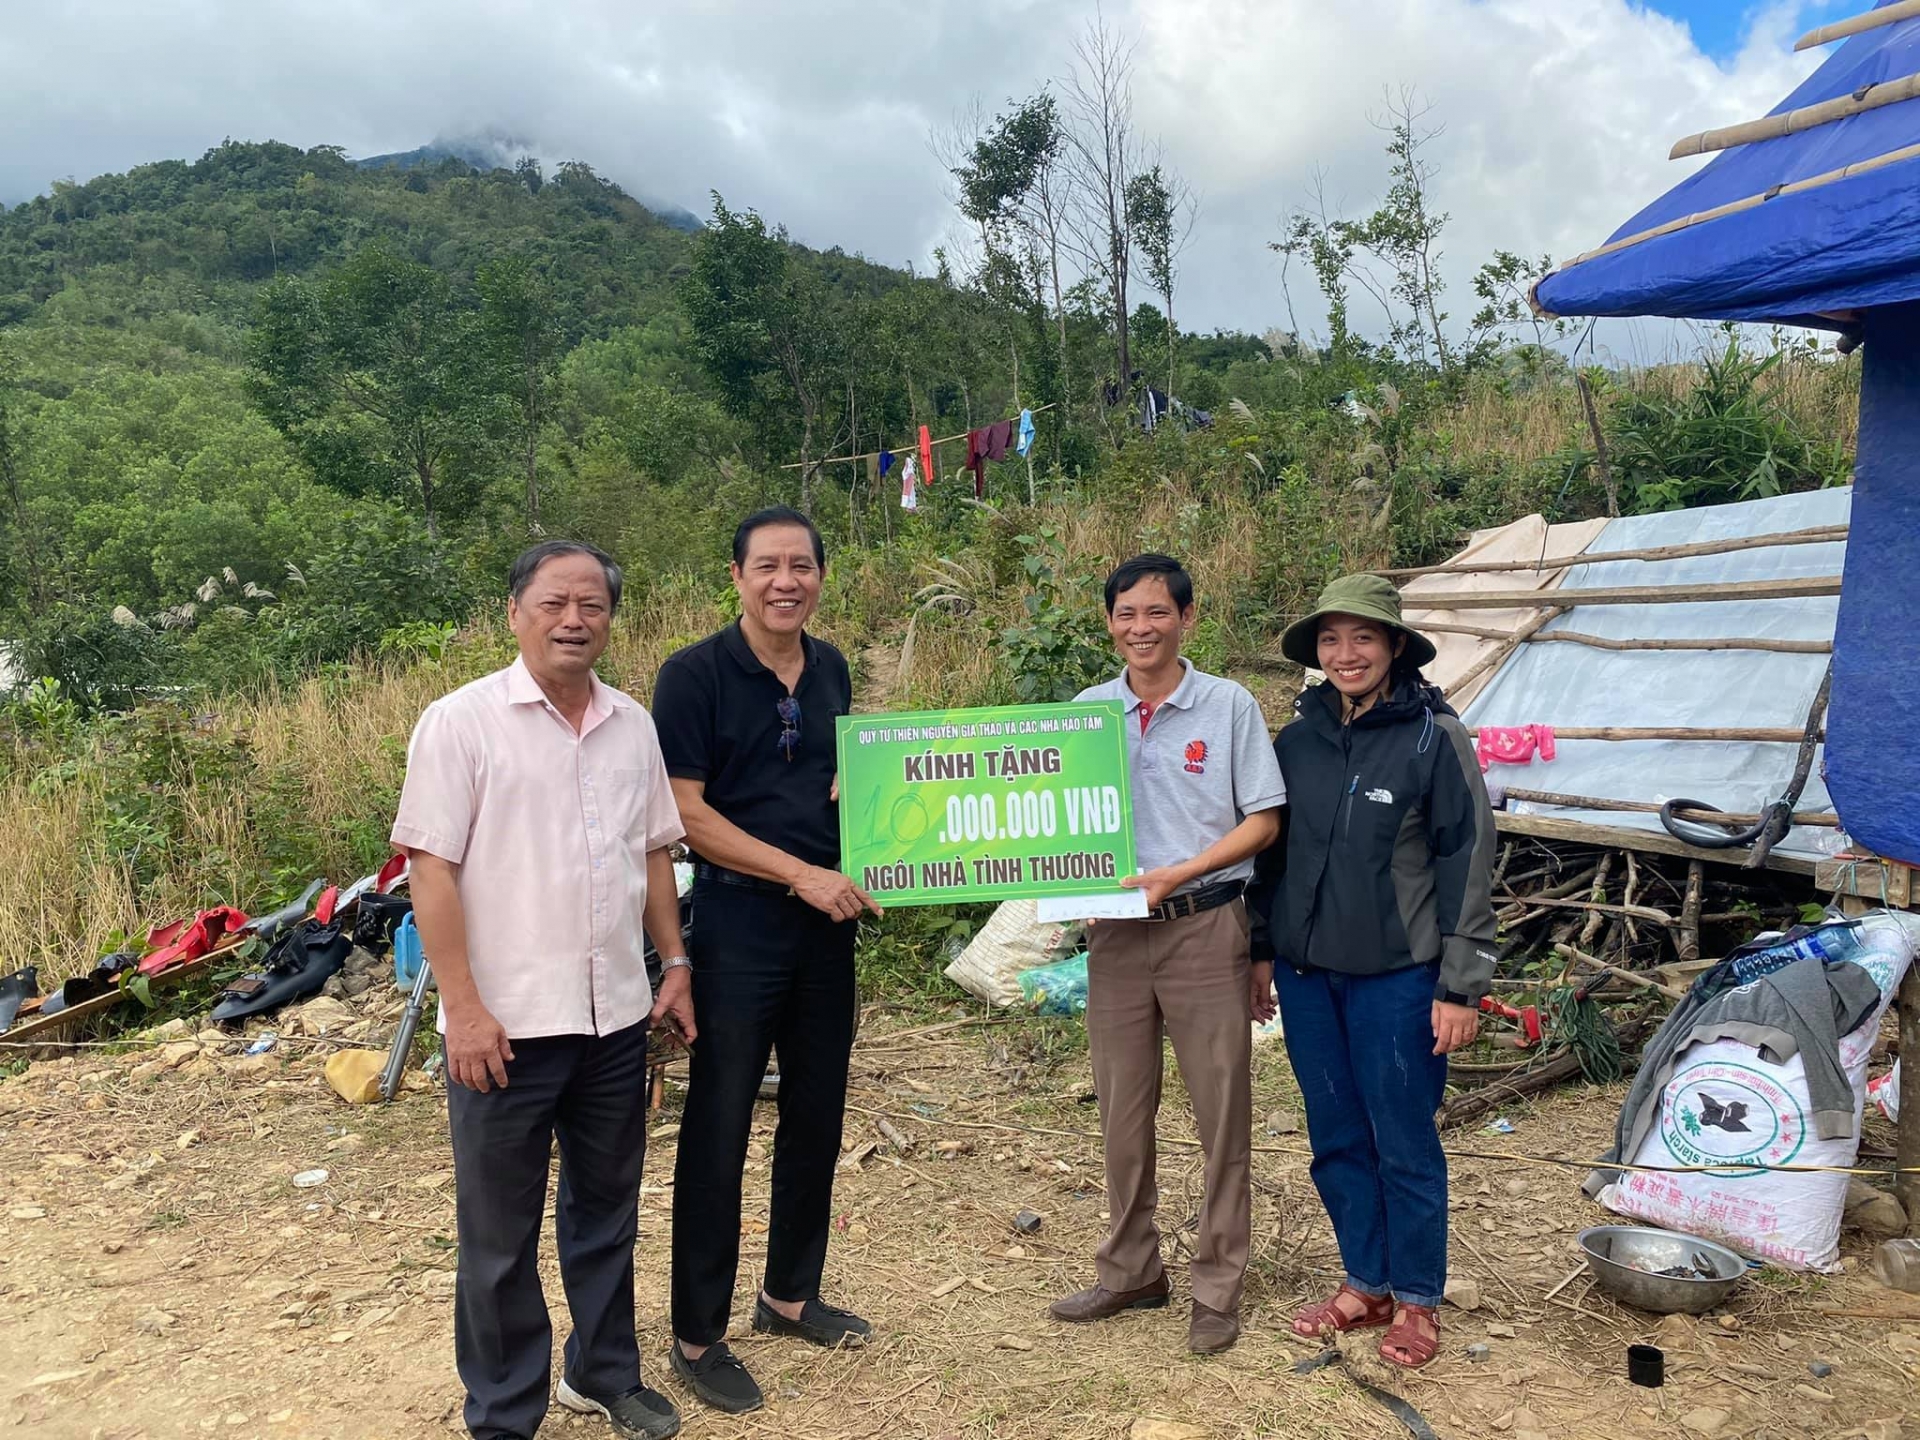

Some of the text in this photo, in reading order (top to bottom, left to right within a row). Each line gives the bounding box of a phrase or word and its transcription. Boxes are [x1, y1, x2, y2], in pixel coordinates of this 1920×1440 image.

[859, 713, 1103, 744] QUỸ TỪ THIỆN NGUYỄN GIA THẢO VÀ CÁC NHÀ HẢO TÂM
[905, 744, 1062, 782] KÍNH TẶNG
[851, 785, 929, 849] 10
[939, 785, 1121, 843] .000.000 VNĐ
[863, 852, 1116, 892] NGÔI NHÀ TÌNH THƯƠNG
[1668, 1130, 1700, 1164] starch
